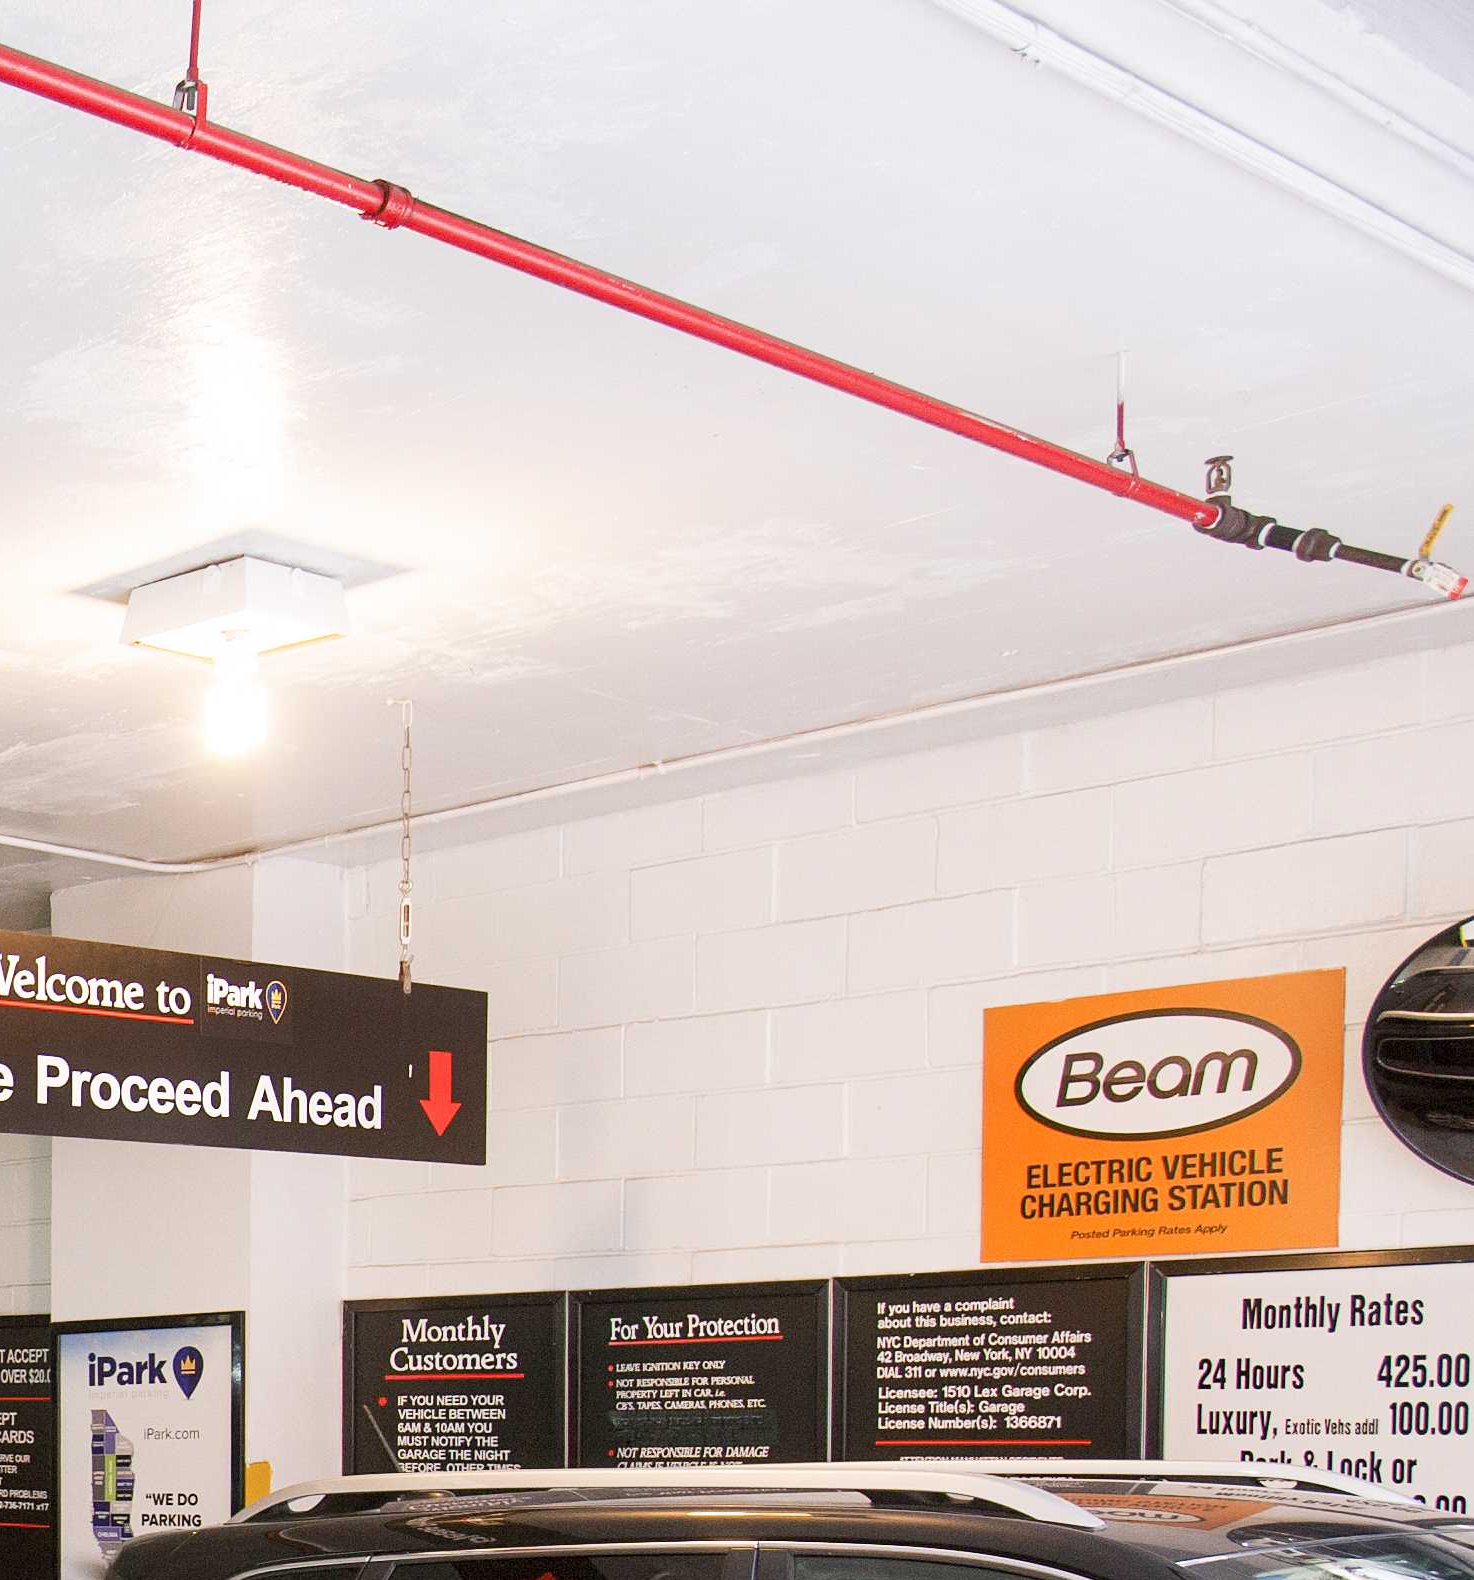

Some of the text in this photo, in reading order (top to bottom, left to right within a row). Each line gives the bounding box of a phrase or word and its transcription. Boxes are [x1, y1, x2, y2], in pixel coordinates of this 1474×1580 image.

[156, 983, 191, 1015] to
[206, 974, 262, 1011] iPark
[1056, 1048, 1258, 1108] Beam
[36, 1055, 230, 1118] Proceed
[248, 1077, 382, 1130] Ahead
[1026, 1147, 1284, 1189] ELECTRIC VEHICLE
[1020, 1179, 1289, 1219] CHARGING STATION
[1071, 1223, 1228, 1240] Posted Parking Rates Apply
[877, 1297, 1014, 1316] If you have a complaint
[1242, 1293, 1424, 1332] Monthly Rates
[610, 1313, 780, 1340] For Your Protection
[878, 1311, 1052, 1329] about this business, contact:
[402, 1315, 505, 1348] Monthly
[877, 1331, 1092, 1350] NYC Department of Consumer Affairs
[7, 1349, 49, 1363] ACCEPT
[390, 1347, 518, 1371] Customers
[877, 1346, 1076, 1364] 42 Broadway, New York, NY 10004
[1, 1369, 27, 1384] OVER
[88, 1353, 167, 1386] iPark
[877, 1363, 1085, 1379] DIAL 311 or www.nyc.gov/consumers
[1198, 1353, 1470, 1390] 24 Hours 425.00
[878, 1383, 1091, 1399] Licensee: 1510 Lex Garage Corp.
[398, 1395, 504, 1406] IF YOU NEED YOUR
[878, 1400, 1025, 1415] License Title(s): Garage
[398, 1409, 506, 1419] VEHICLE BETWEEN
[878, 1416, 1061, 1429] License Number(s): 1366871
[1197, 1401, 1468, 1440] Luxury, Exotic Vehs addl 100.00
[144, 1428, 199, 1440] iPark.com
[398, 1423, 492, 1433] 6AM & 10AM YOU
[397, 1436, 498, 1446] MUST NOTIFY THE
[398, 1449, 510, 1461] GARAGE THE NIGHT
[1392, 1455, 1417, 1484] or
[178, 1493, 198, 1506] DO
[142, 1514, 201, 1527] PARKING
